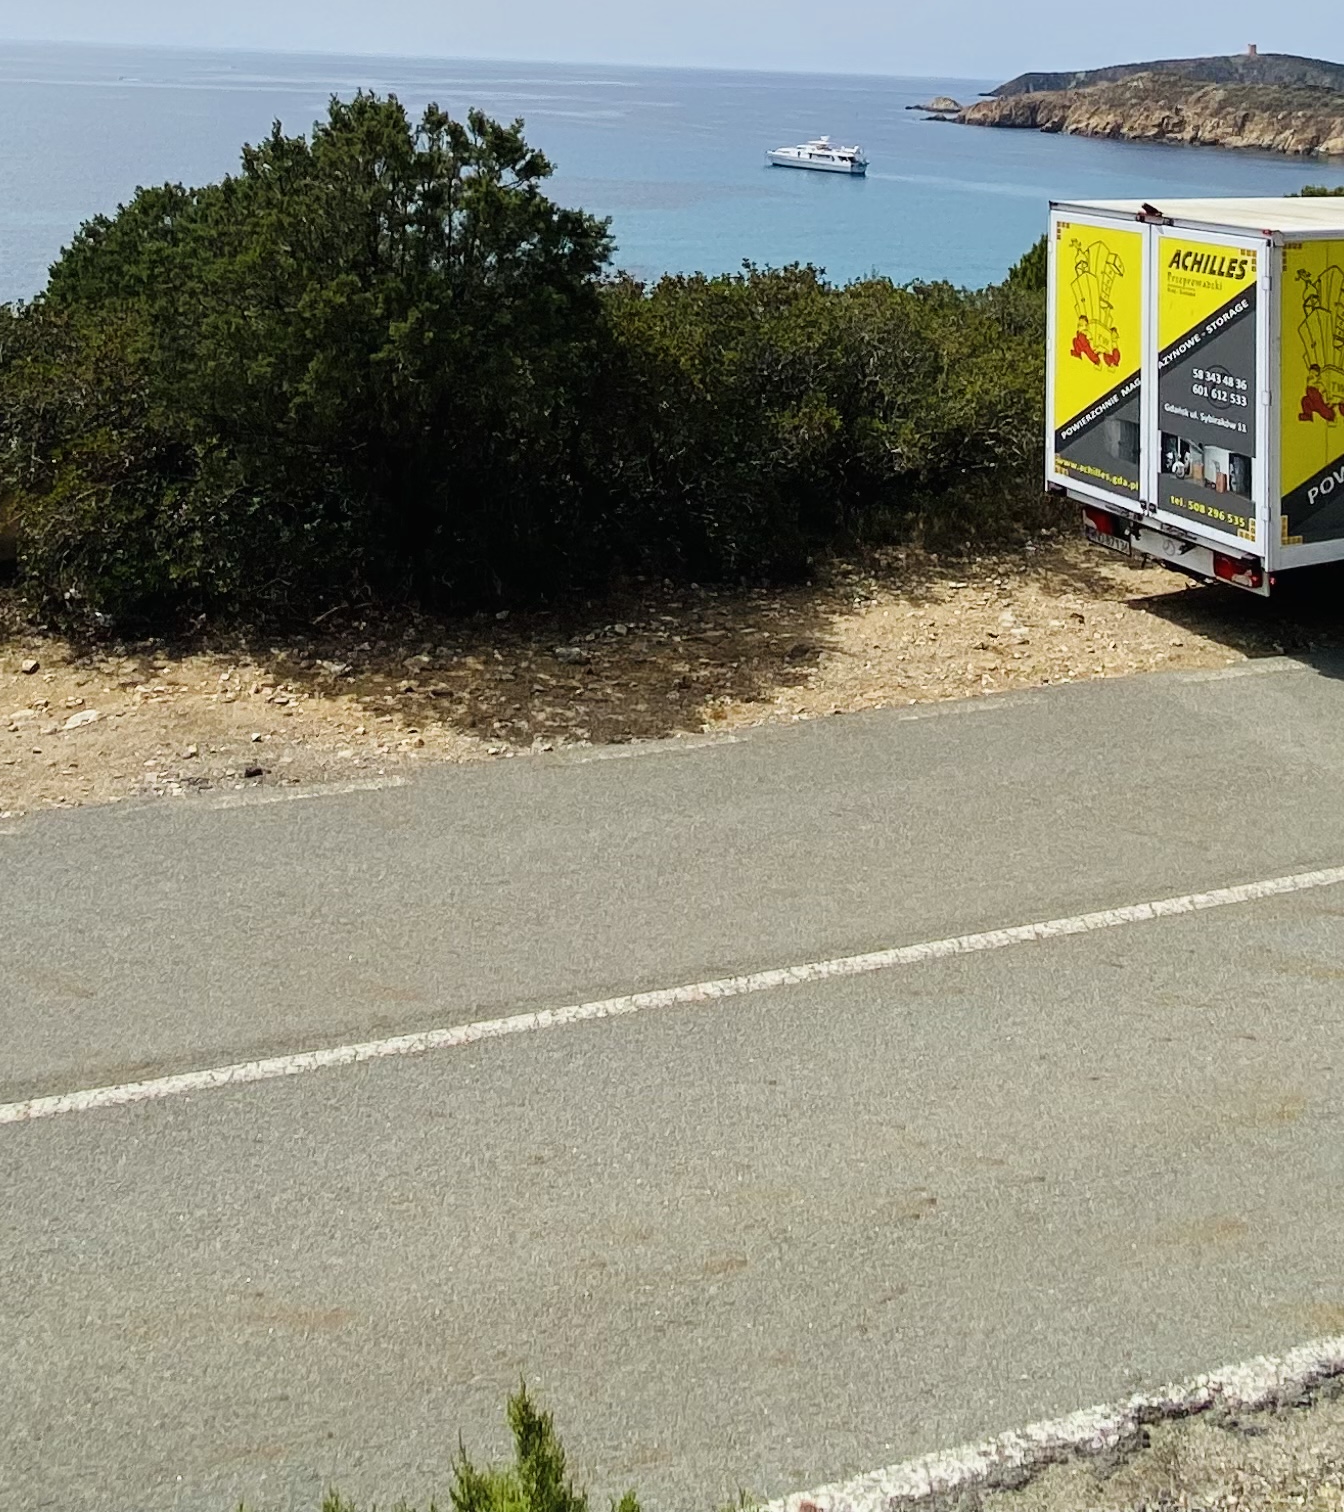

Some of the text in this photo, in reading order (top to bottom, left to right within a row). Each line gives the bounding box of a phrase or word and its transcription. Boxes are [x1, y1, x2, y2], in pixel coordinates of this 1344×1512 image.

[1168, 249, 1248, 280] ACHILLES
[1060, 394, 1119, 440] POWIERZCHNIE
[1205, 299, 1249, 334] STORAGE
[1192, 369, 1247, 390] 58 343 48 36
[1192, 384, 1247, 406] 601 612 533
[1237, 423, 1247, 432] 11
[1170, 495, 1245, 527] tel. 508 296 535
